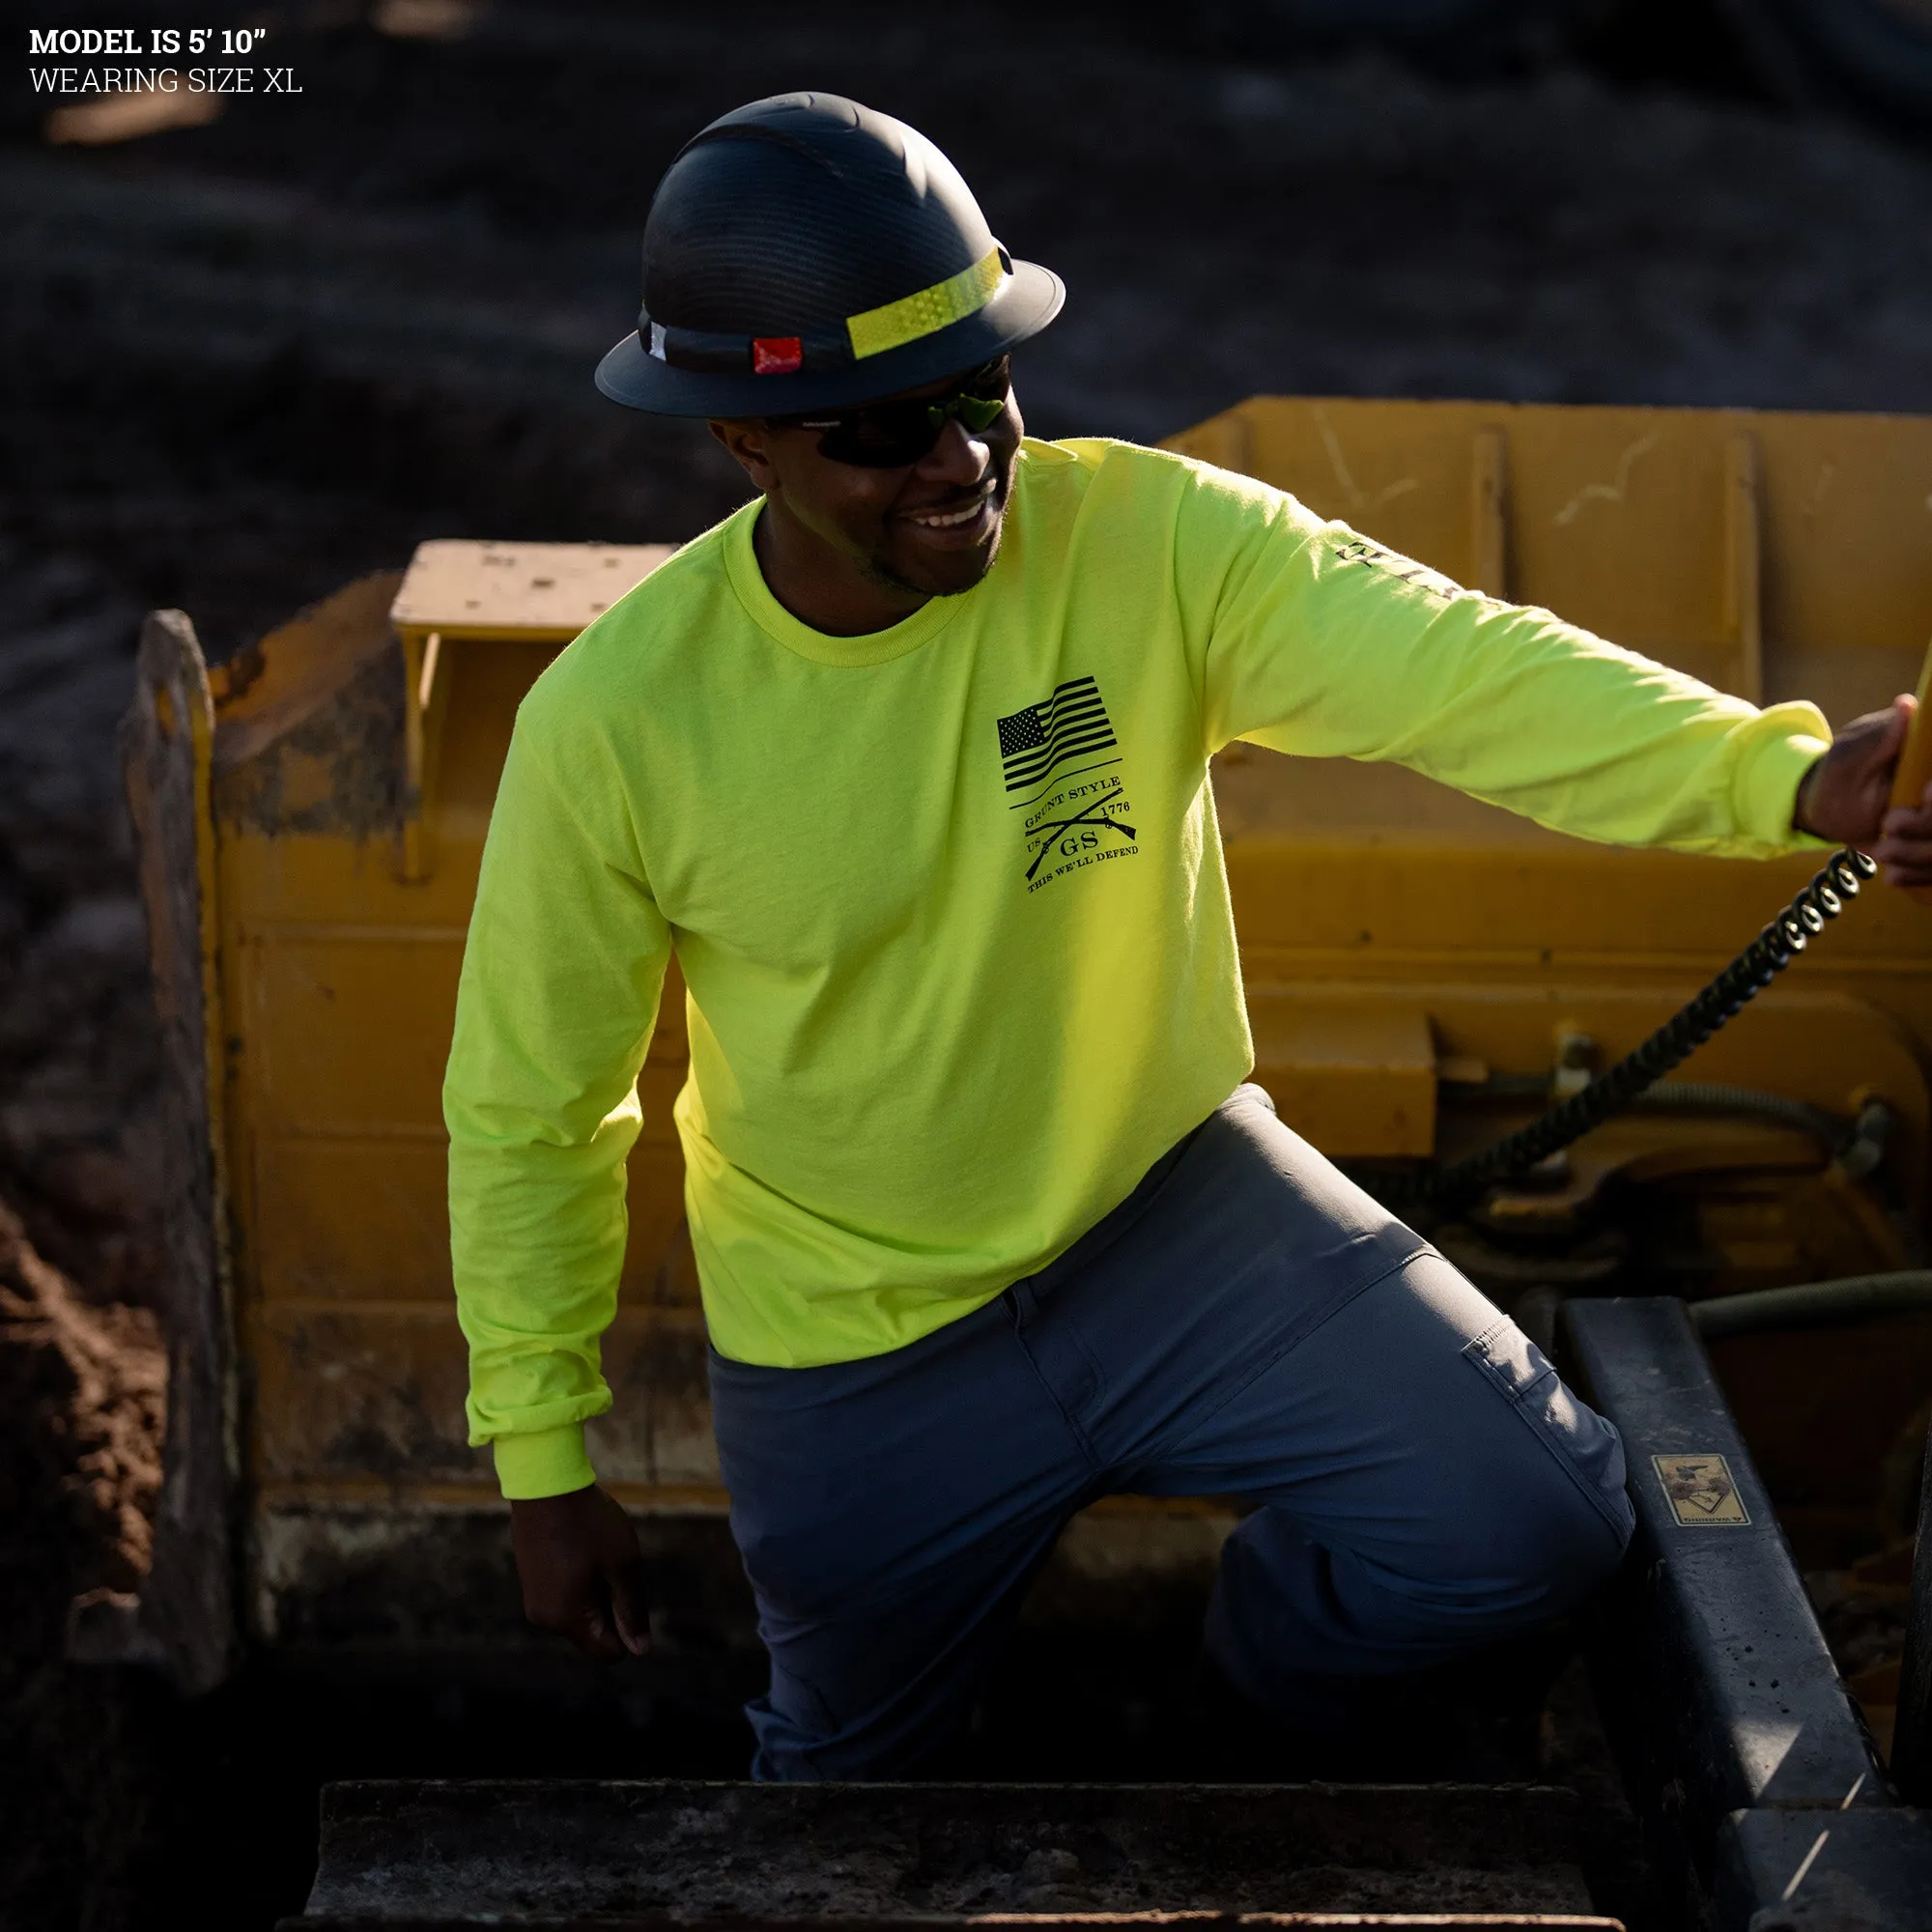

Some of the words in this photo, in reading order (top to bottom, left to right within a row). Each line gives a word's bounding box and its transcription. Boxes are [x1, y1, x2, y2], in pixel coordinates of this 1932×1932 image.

[1025, 793, 1065, 829] GRUNT
[1067, 776, 1122, 800] STYLE
[1100, 801, 1130, 817] 1776
[1027, 838, 1041, 853] US
[1060, 831, 1098, 857] GS
[1028, 873, 1053, 894] THIS
[1055, 857, 1094, 877] WE'LL
[1095, 845, 1139, 862] DEFEND
